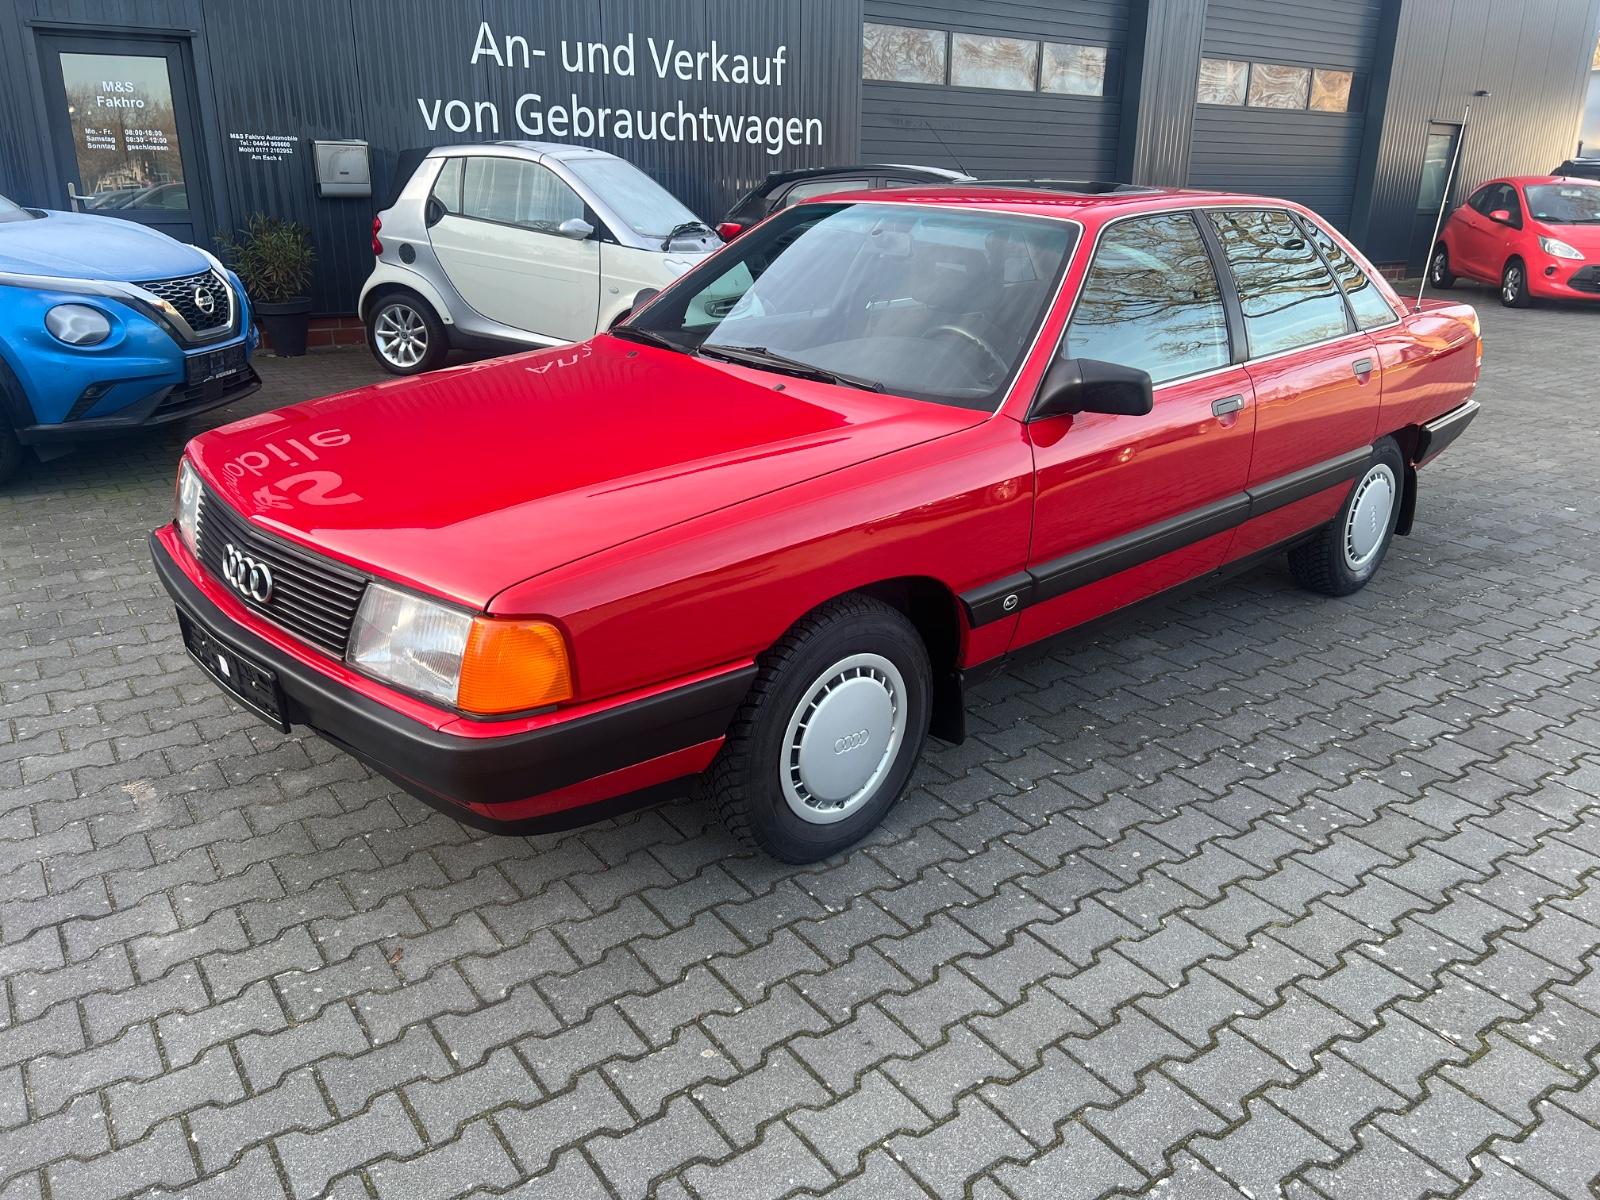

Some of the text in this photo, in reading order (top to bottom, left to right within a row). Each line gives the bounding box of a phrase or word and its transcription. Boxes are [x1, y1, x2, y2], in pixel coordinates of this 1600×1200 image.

[470, 21, 786, 86] An- und Verkauf
[102, 80, 134, 92] M&S
[96, 96, 145, 108] Fakhro
[417, 93, 823, 156] von Gebrauchtwagen
[86, 135, 116, 144] Samstag
[87, 142, 116, 151] Sonntag
